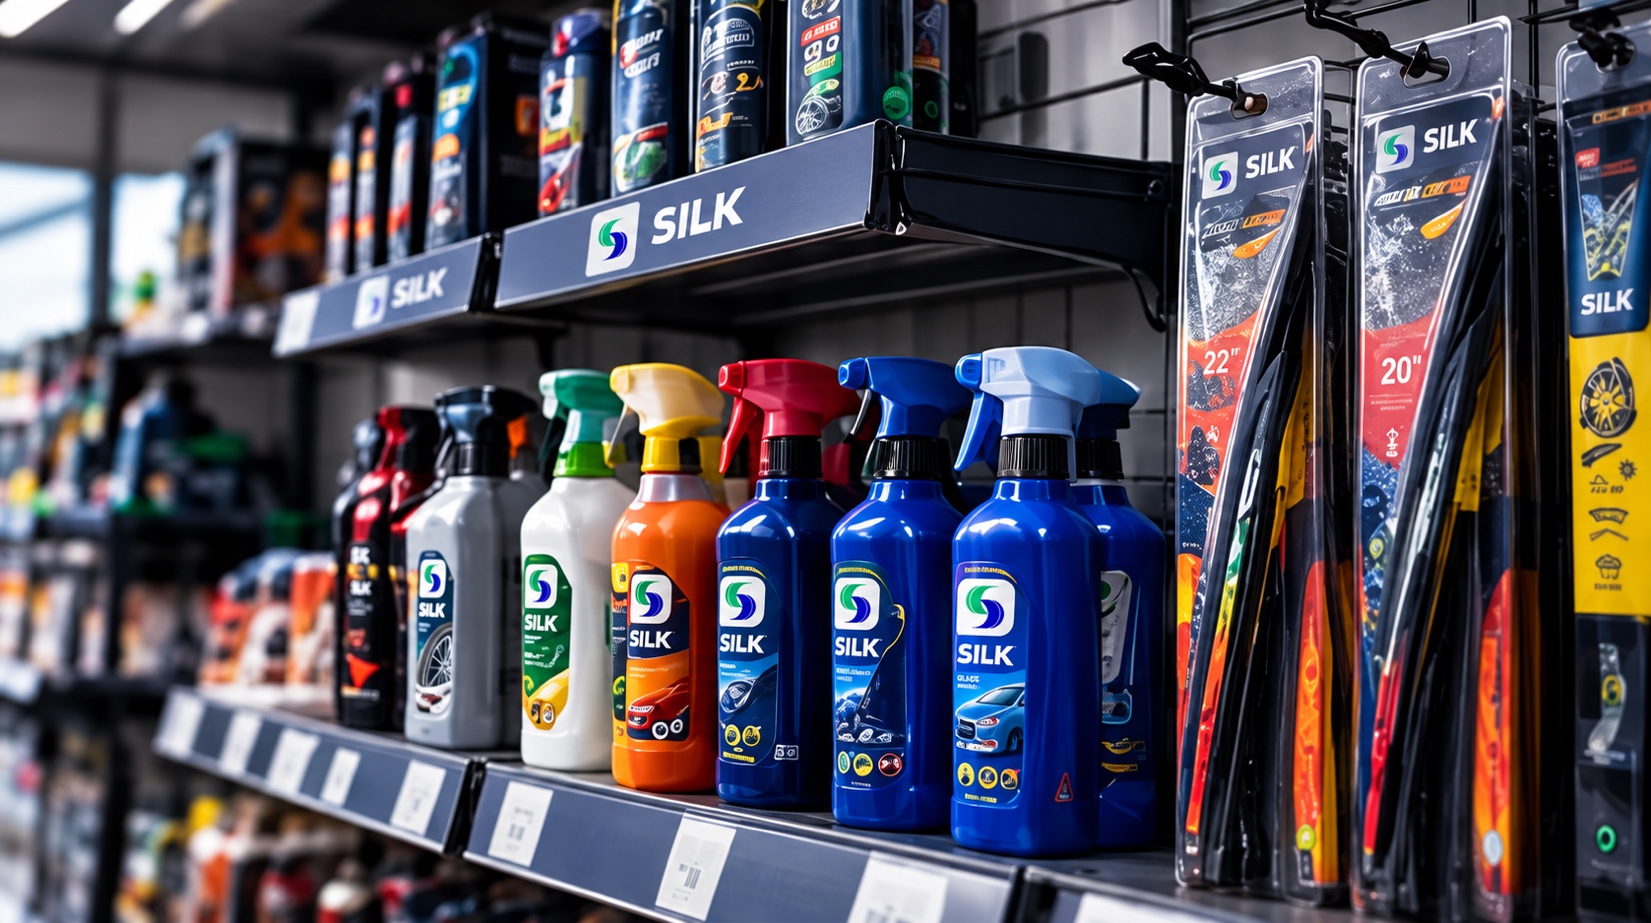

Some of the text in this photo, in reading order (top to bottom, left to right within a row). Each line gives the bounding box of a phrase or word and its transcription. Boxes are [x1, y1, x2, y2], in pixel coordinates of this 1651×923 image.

[1424, 118, 1478, 153] SILK
[1245, 146, 1296, 179] SILK
[651, 186, 747, 245] SILK
[390, 267, 448, 308] SILK
[1580, 288, 1634, 315] SILK
[1203, 347, 1241, 375] 22"
[1380, 355, 1422, 385] 20"
[418, 602, 446, 618] SILK
[524, 614, 558, 632] SILK
[629, 630, 673, 649] SILK
[719, 633, 765, 654] SILK
[834, 636, 880, 658] SILK
[957, 643, 1014, 666] SILK
